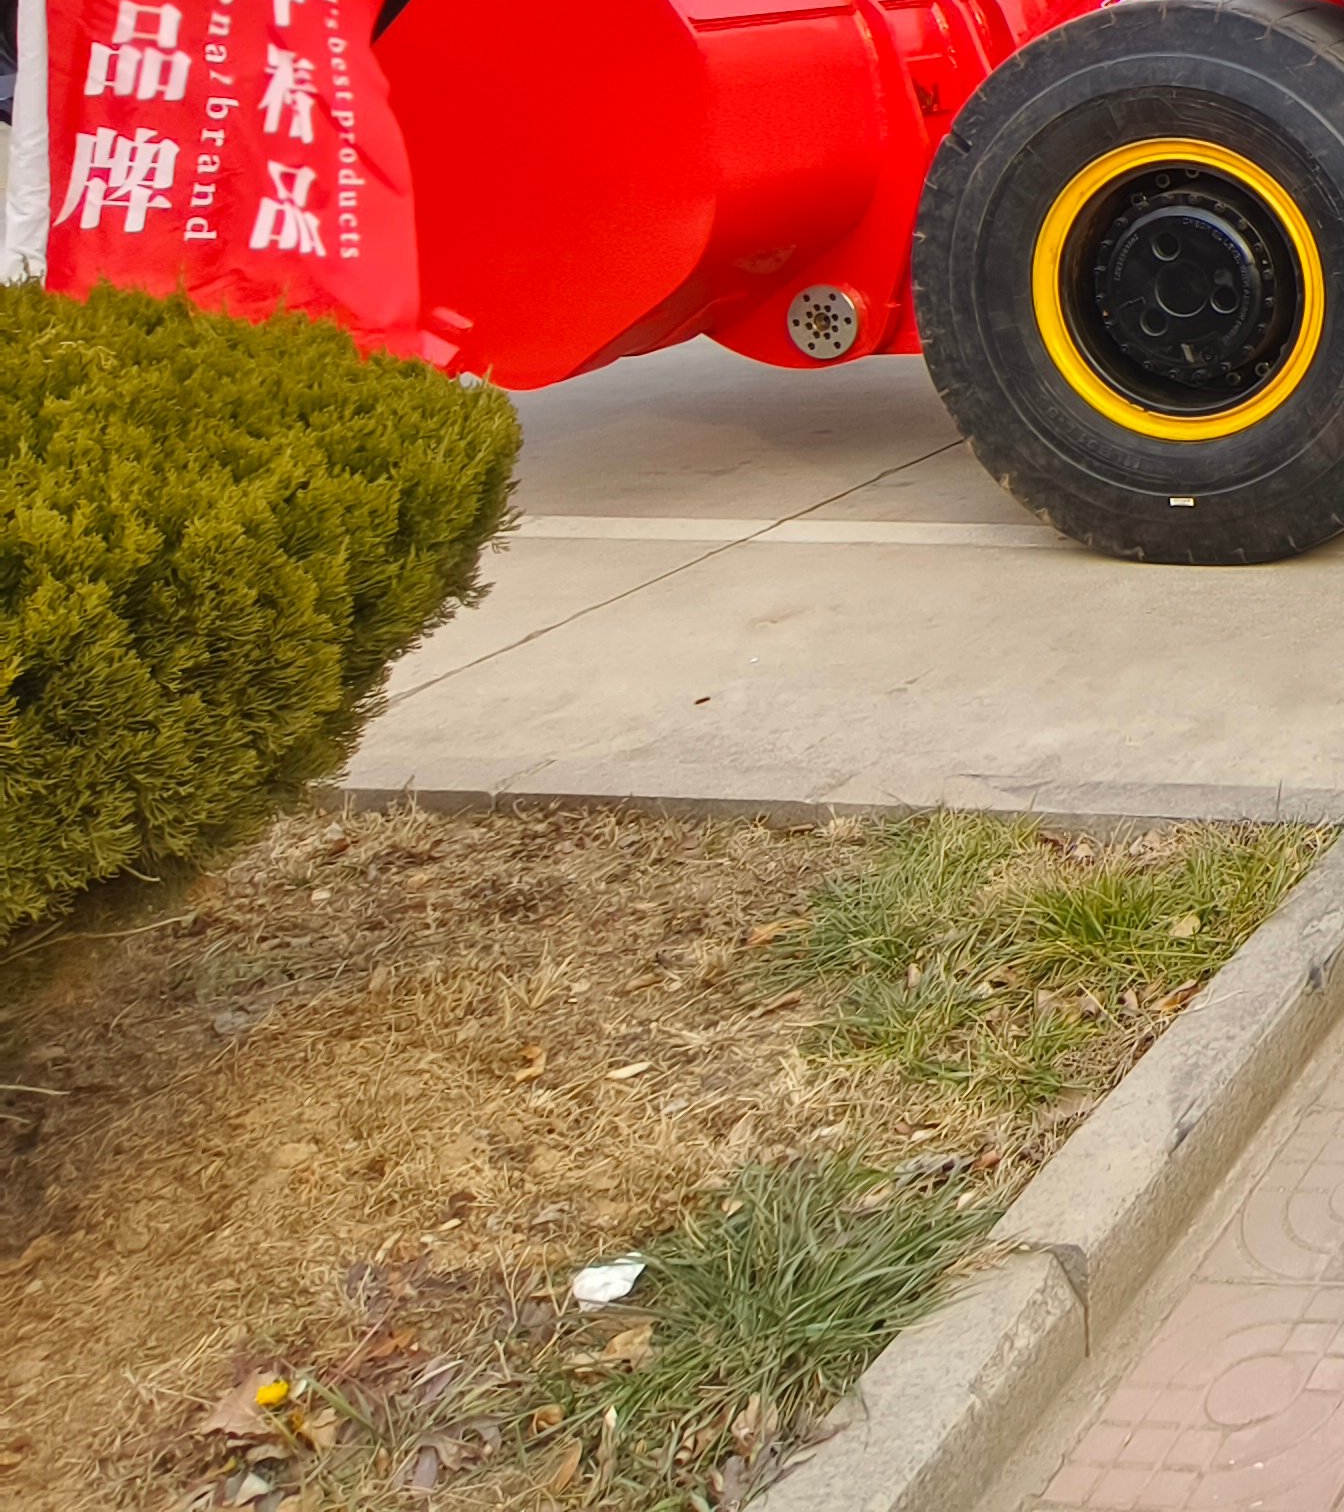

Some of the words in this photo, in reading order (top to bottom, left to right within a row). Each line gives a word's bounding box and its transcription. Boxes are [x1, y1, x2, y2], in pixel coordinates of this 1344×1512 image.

[327, 36, 354, 101] best
[184, 97, 239, 242] brand
[331, 109, 366, 260] products
